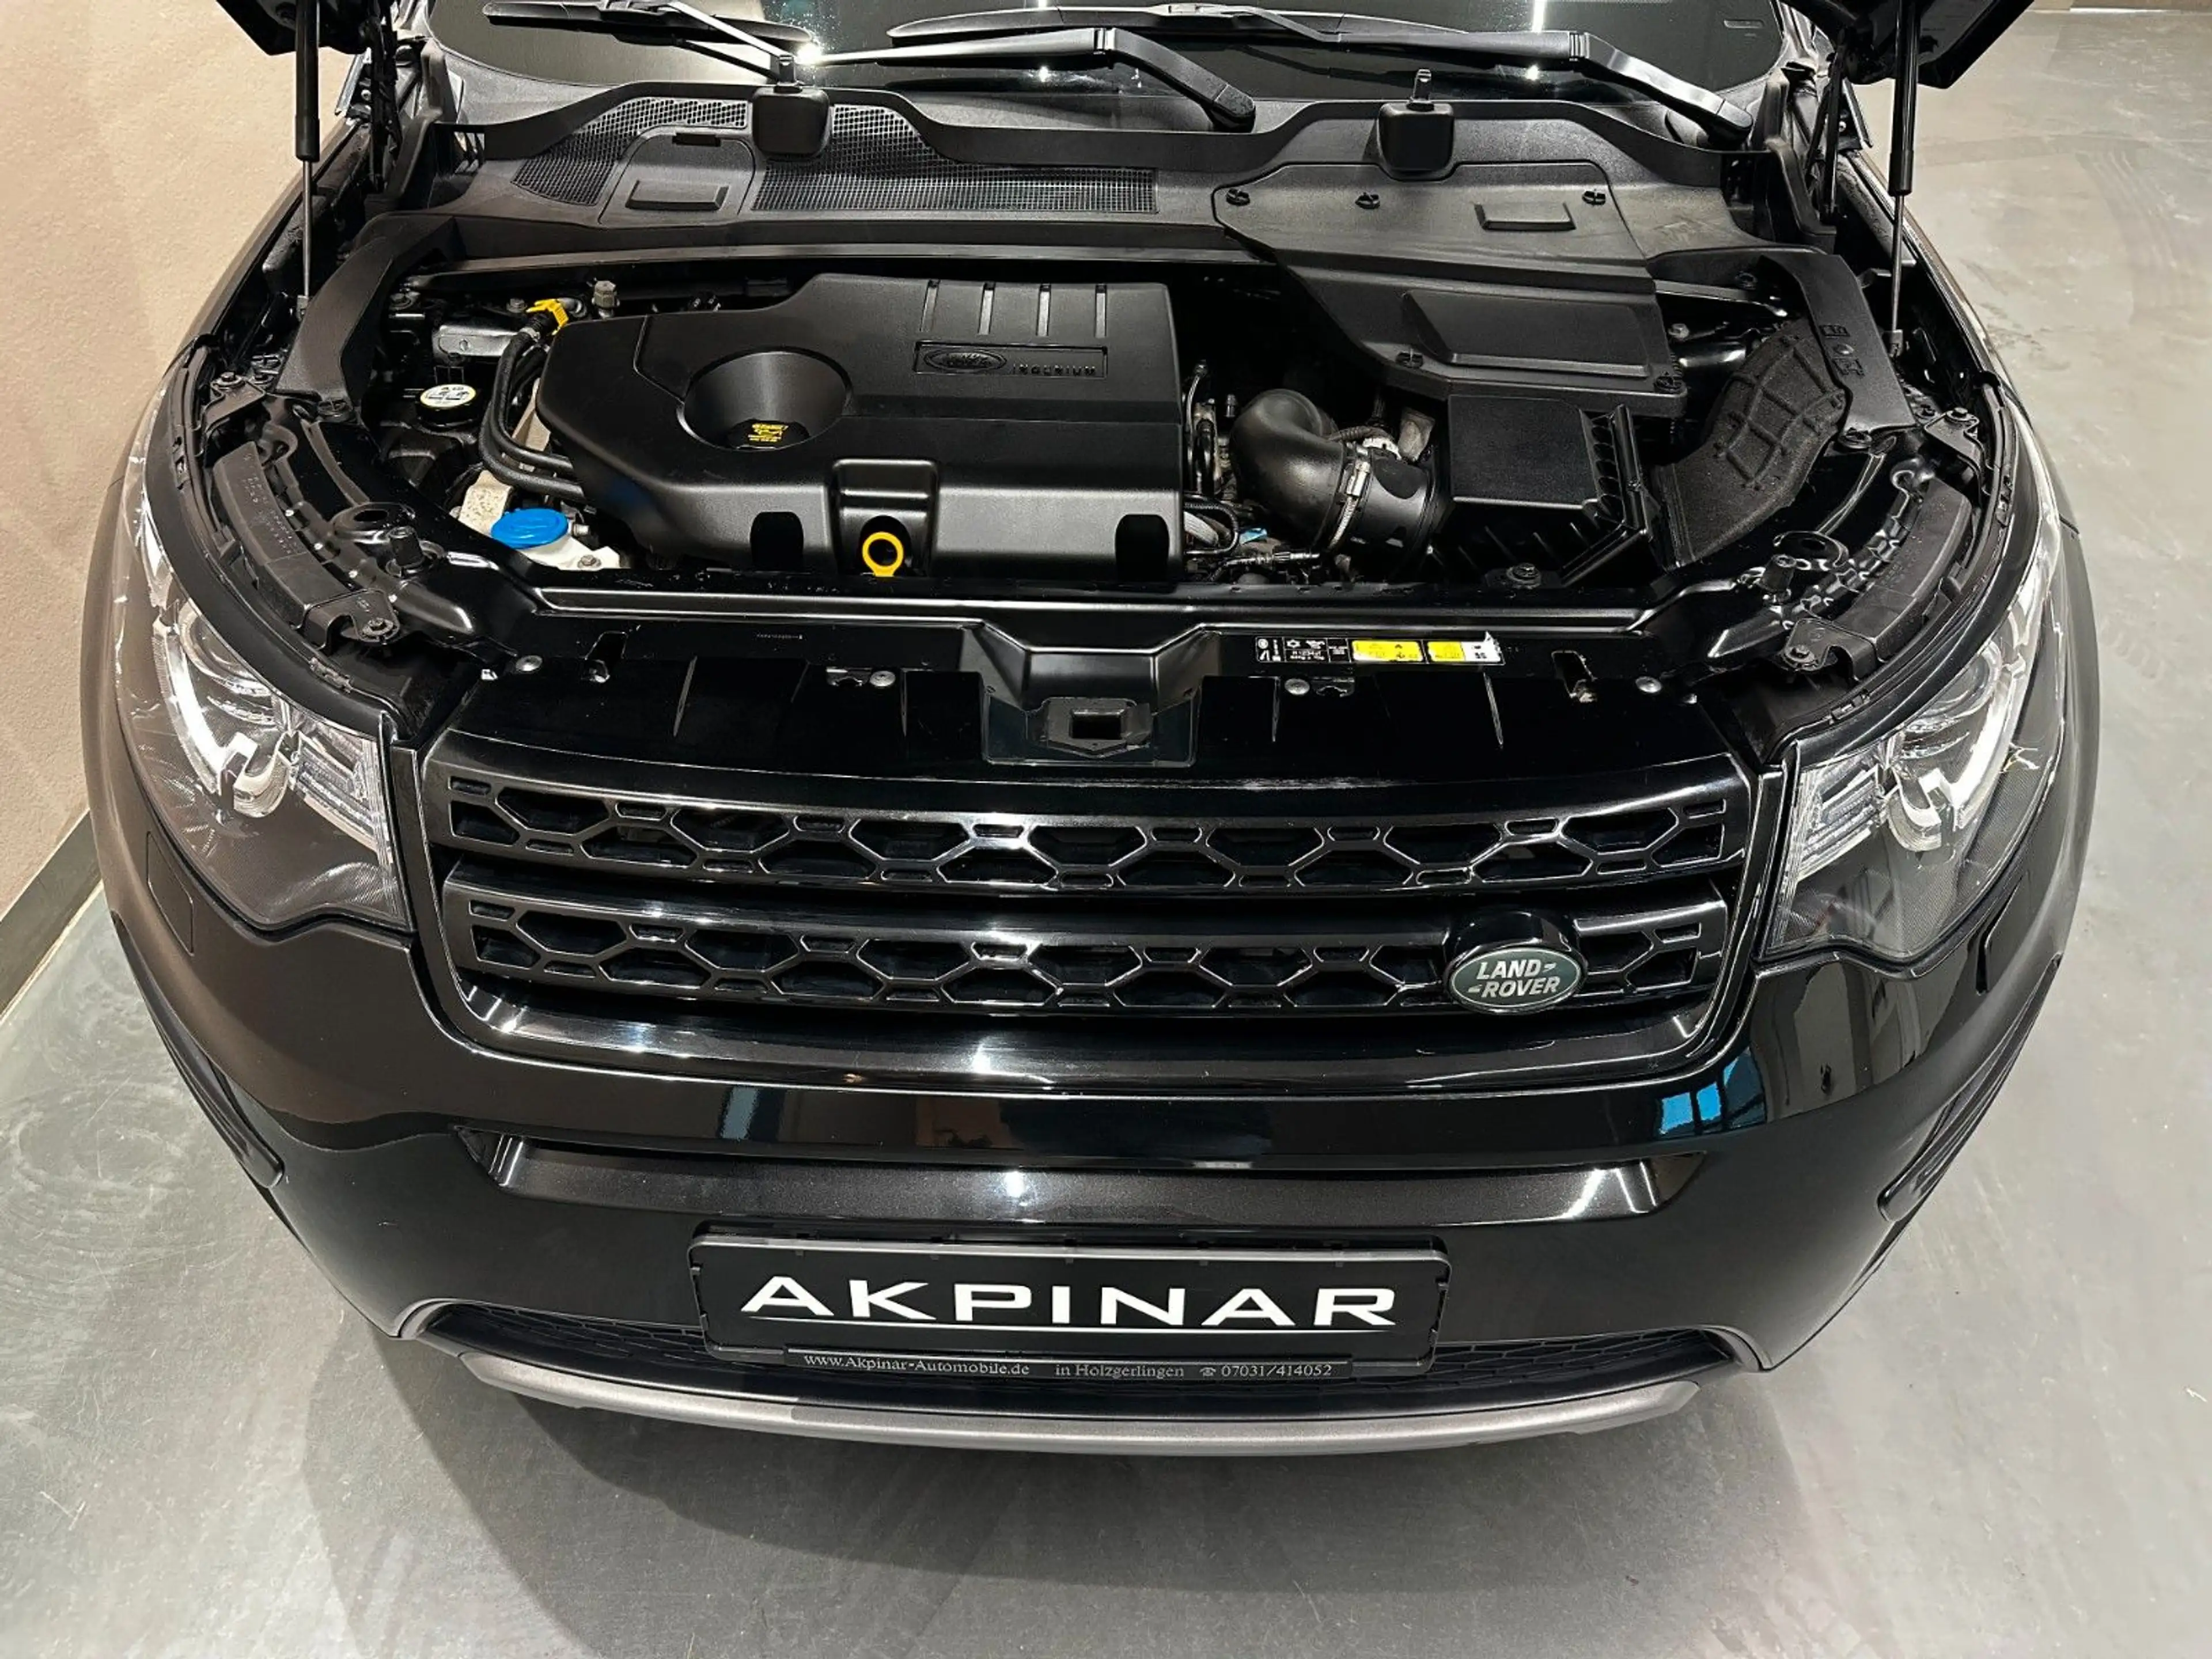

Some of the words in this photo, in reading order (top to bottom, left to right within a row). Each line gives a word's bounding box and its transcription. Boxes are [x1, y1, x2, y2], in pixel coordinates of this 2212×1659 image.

[1476, 959, 1541, 979] LAND
[1481, 976, 1560, 998] ROVER
[741, 1276, 1396, 1326] AKPINAR
[804, 1354, 1030, 1376] www.Akpinar-Automobile.de
[1055, 1363, 1071, 1376] in
[1075, 1364, 1184, 1379] Holzgerlingen
[1221, 1364, 1332, 1377] 07031/414052
